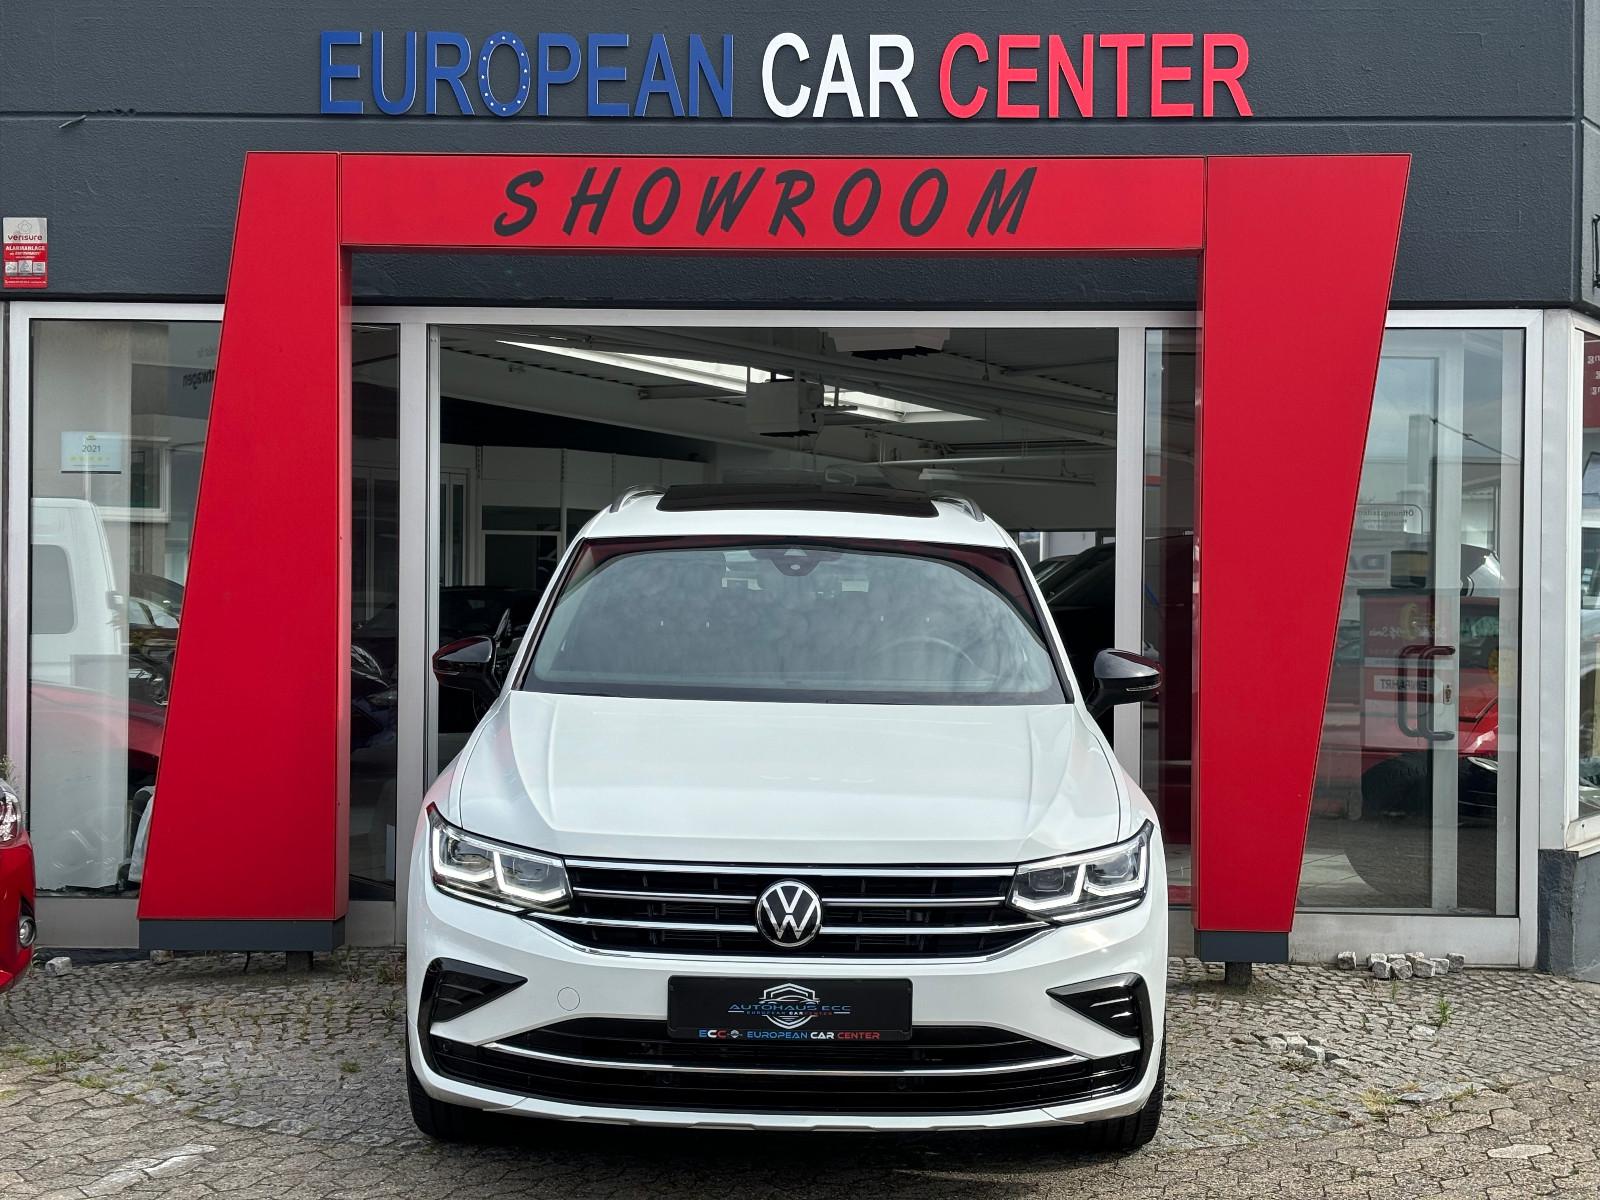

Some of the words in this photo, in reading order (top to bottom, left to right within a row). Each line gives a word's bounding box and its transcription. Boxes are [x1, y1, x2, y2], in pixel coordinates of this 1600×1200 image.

[320, 31, 734, 118] EUROPEAN
[761, 32, 919, 118] CAR
[938, 32, 1254, 119] CENTER
[493, 165, 1038, 238] SHOWROOM
[82, 444, 101, 453] 2021
[728, 1003, 817, 1011] AUTOHAUS
[698, 1029, 727, 1038] ECC
[746, 1031, 808, 1040] EUROPEAN
[810, 1031, 835, 1040] CAR
[837, 1032, 880, 1040] CENTER
